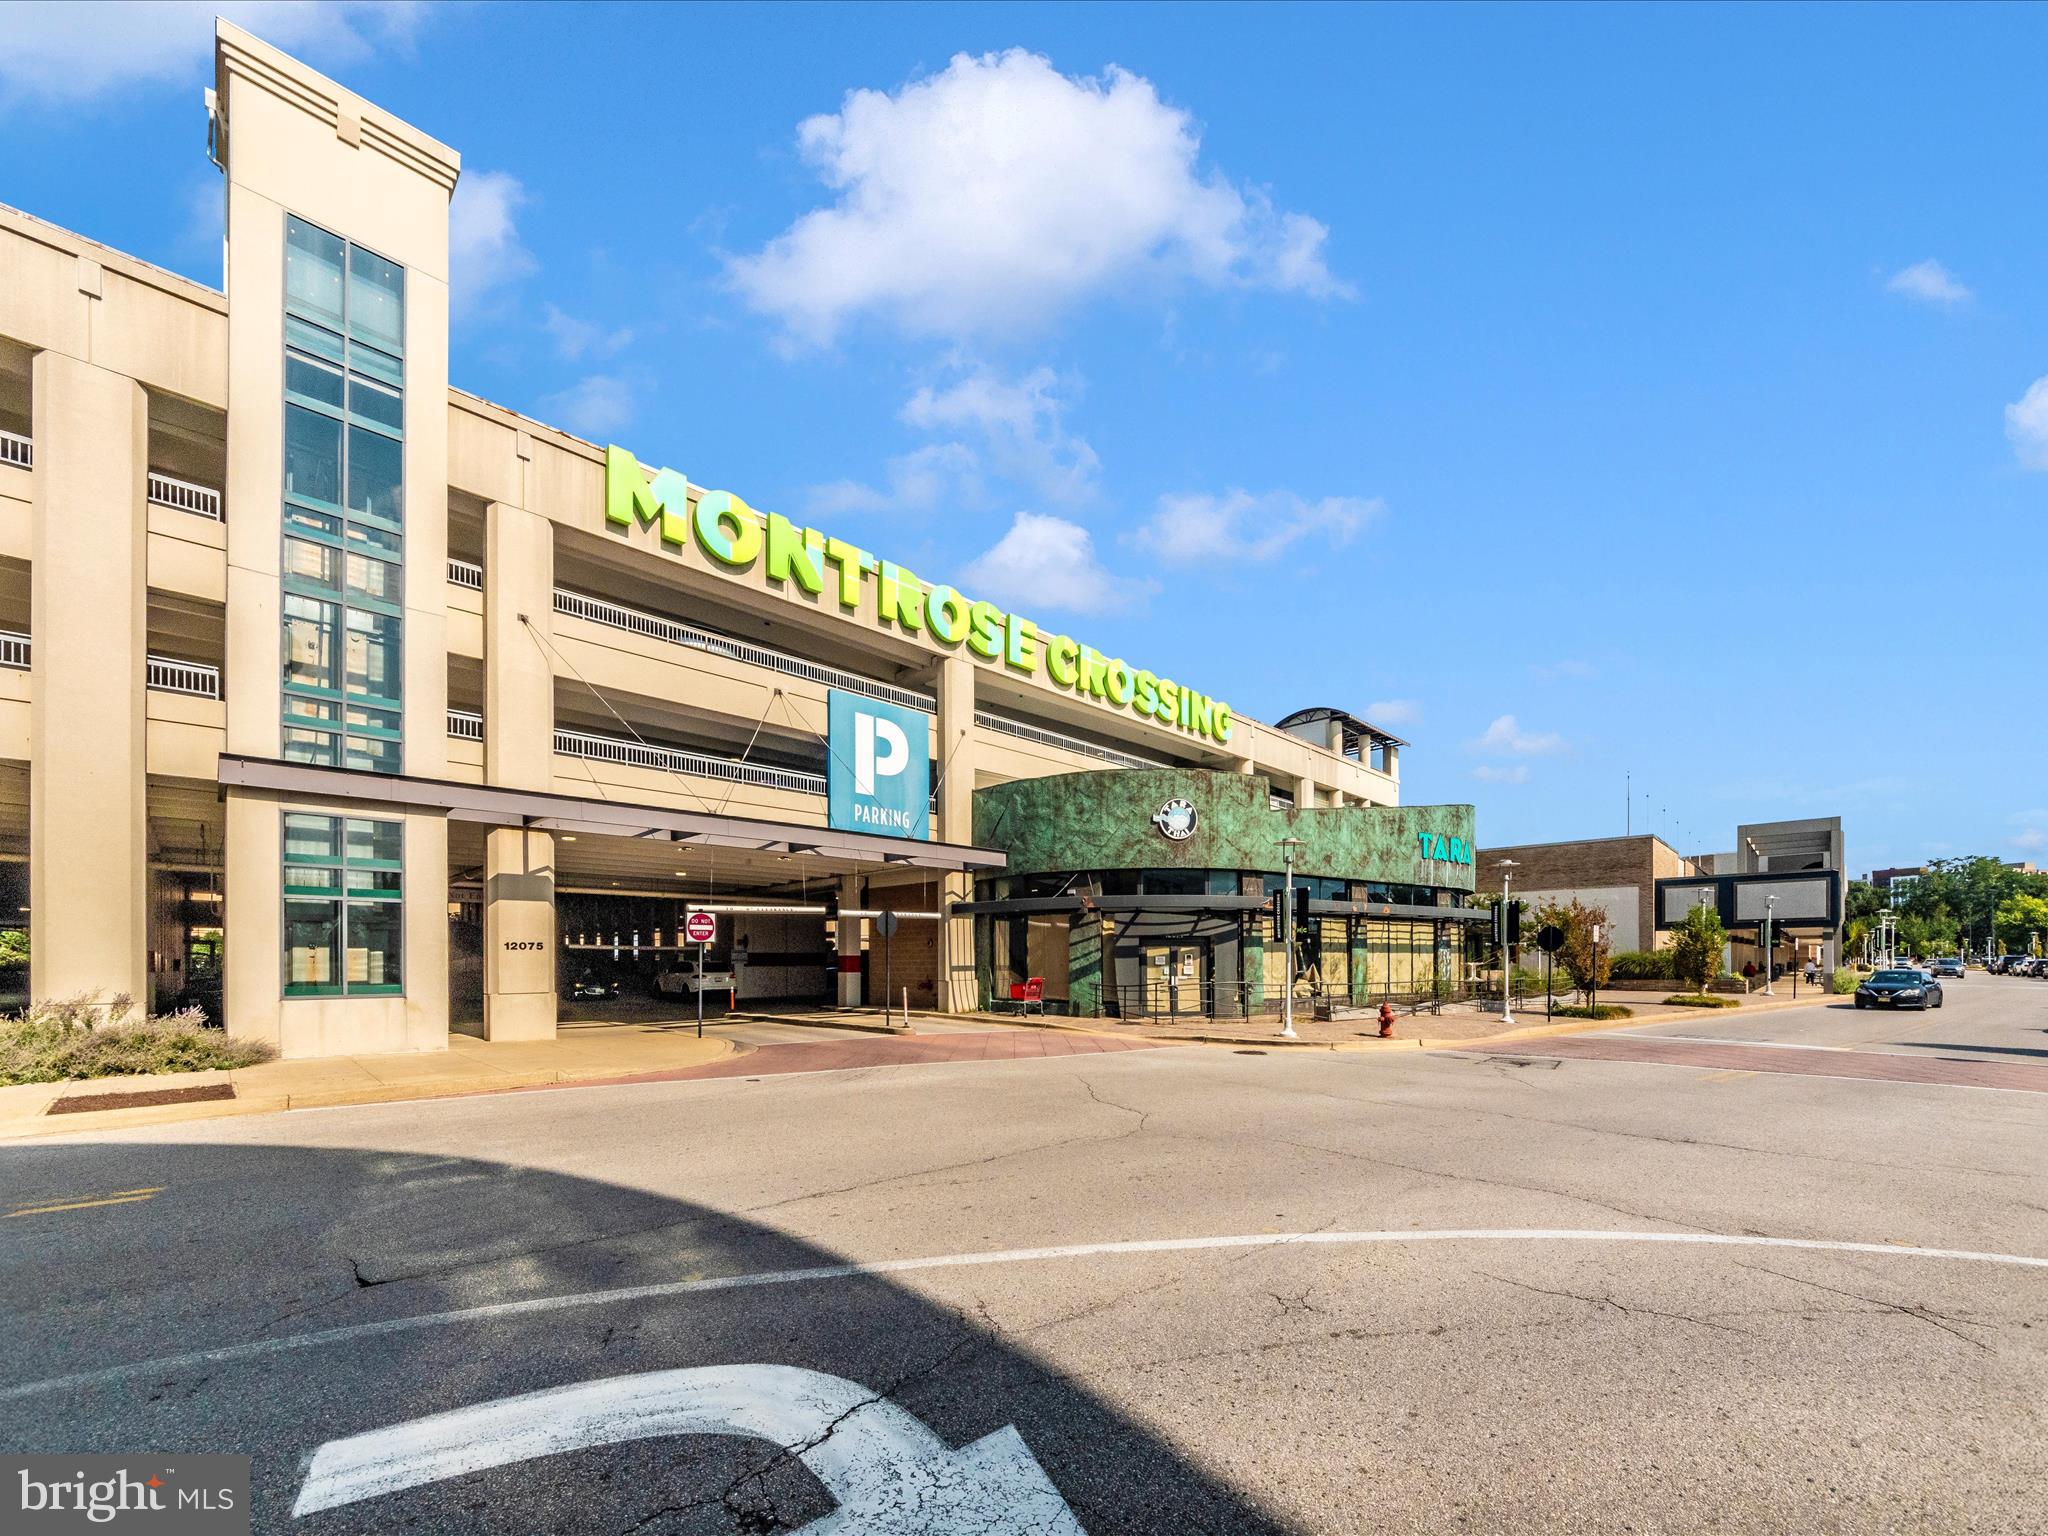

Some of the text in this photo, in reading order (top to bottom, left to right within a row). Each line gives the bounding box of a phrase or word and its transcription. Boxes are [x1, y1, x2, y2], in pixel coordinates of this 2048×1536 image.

[605, 443, 1232, 742] MONTROSE CROSSING
[854, 711, 909, 796] P
[854, 803, 910, 829] PARKING
[1163, 800, 1193, 815] TARA
[1167, 826, 1190, 838] THAI
[1417, 831, 1472, 866] TARA
[503, 941, 544, 951] 12075
